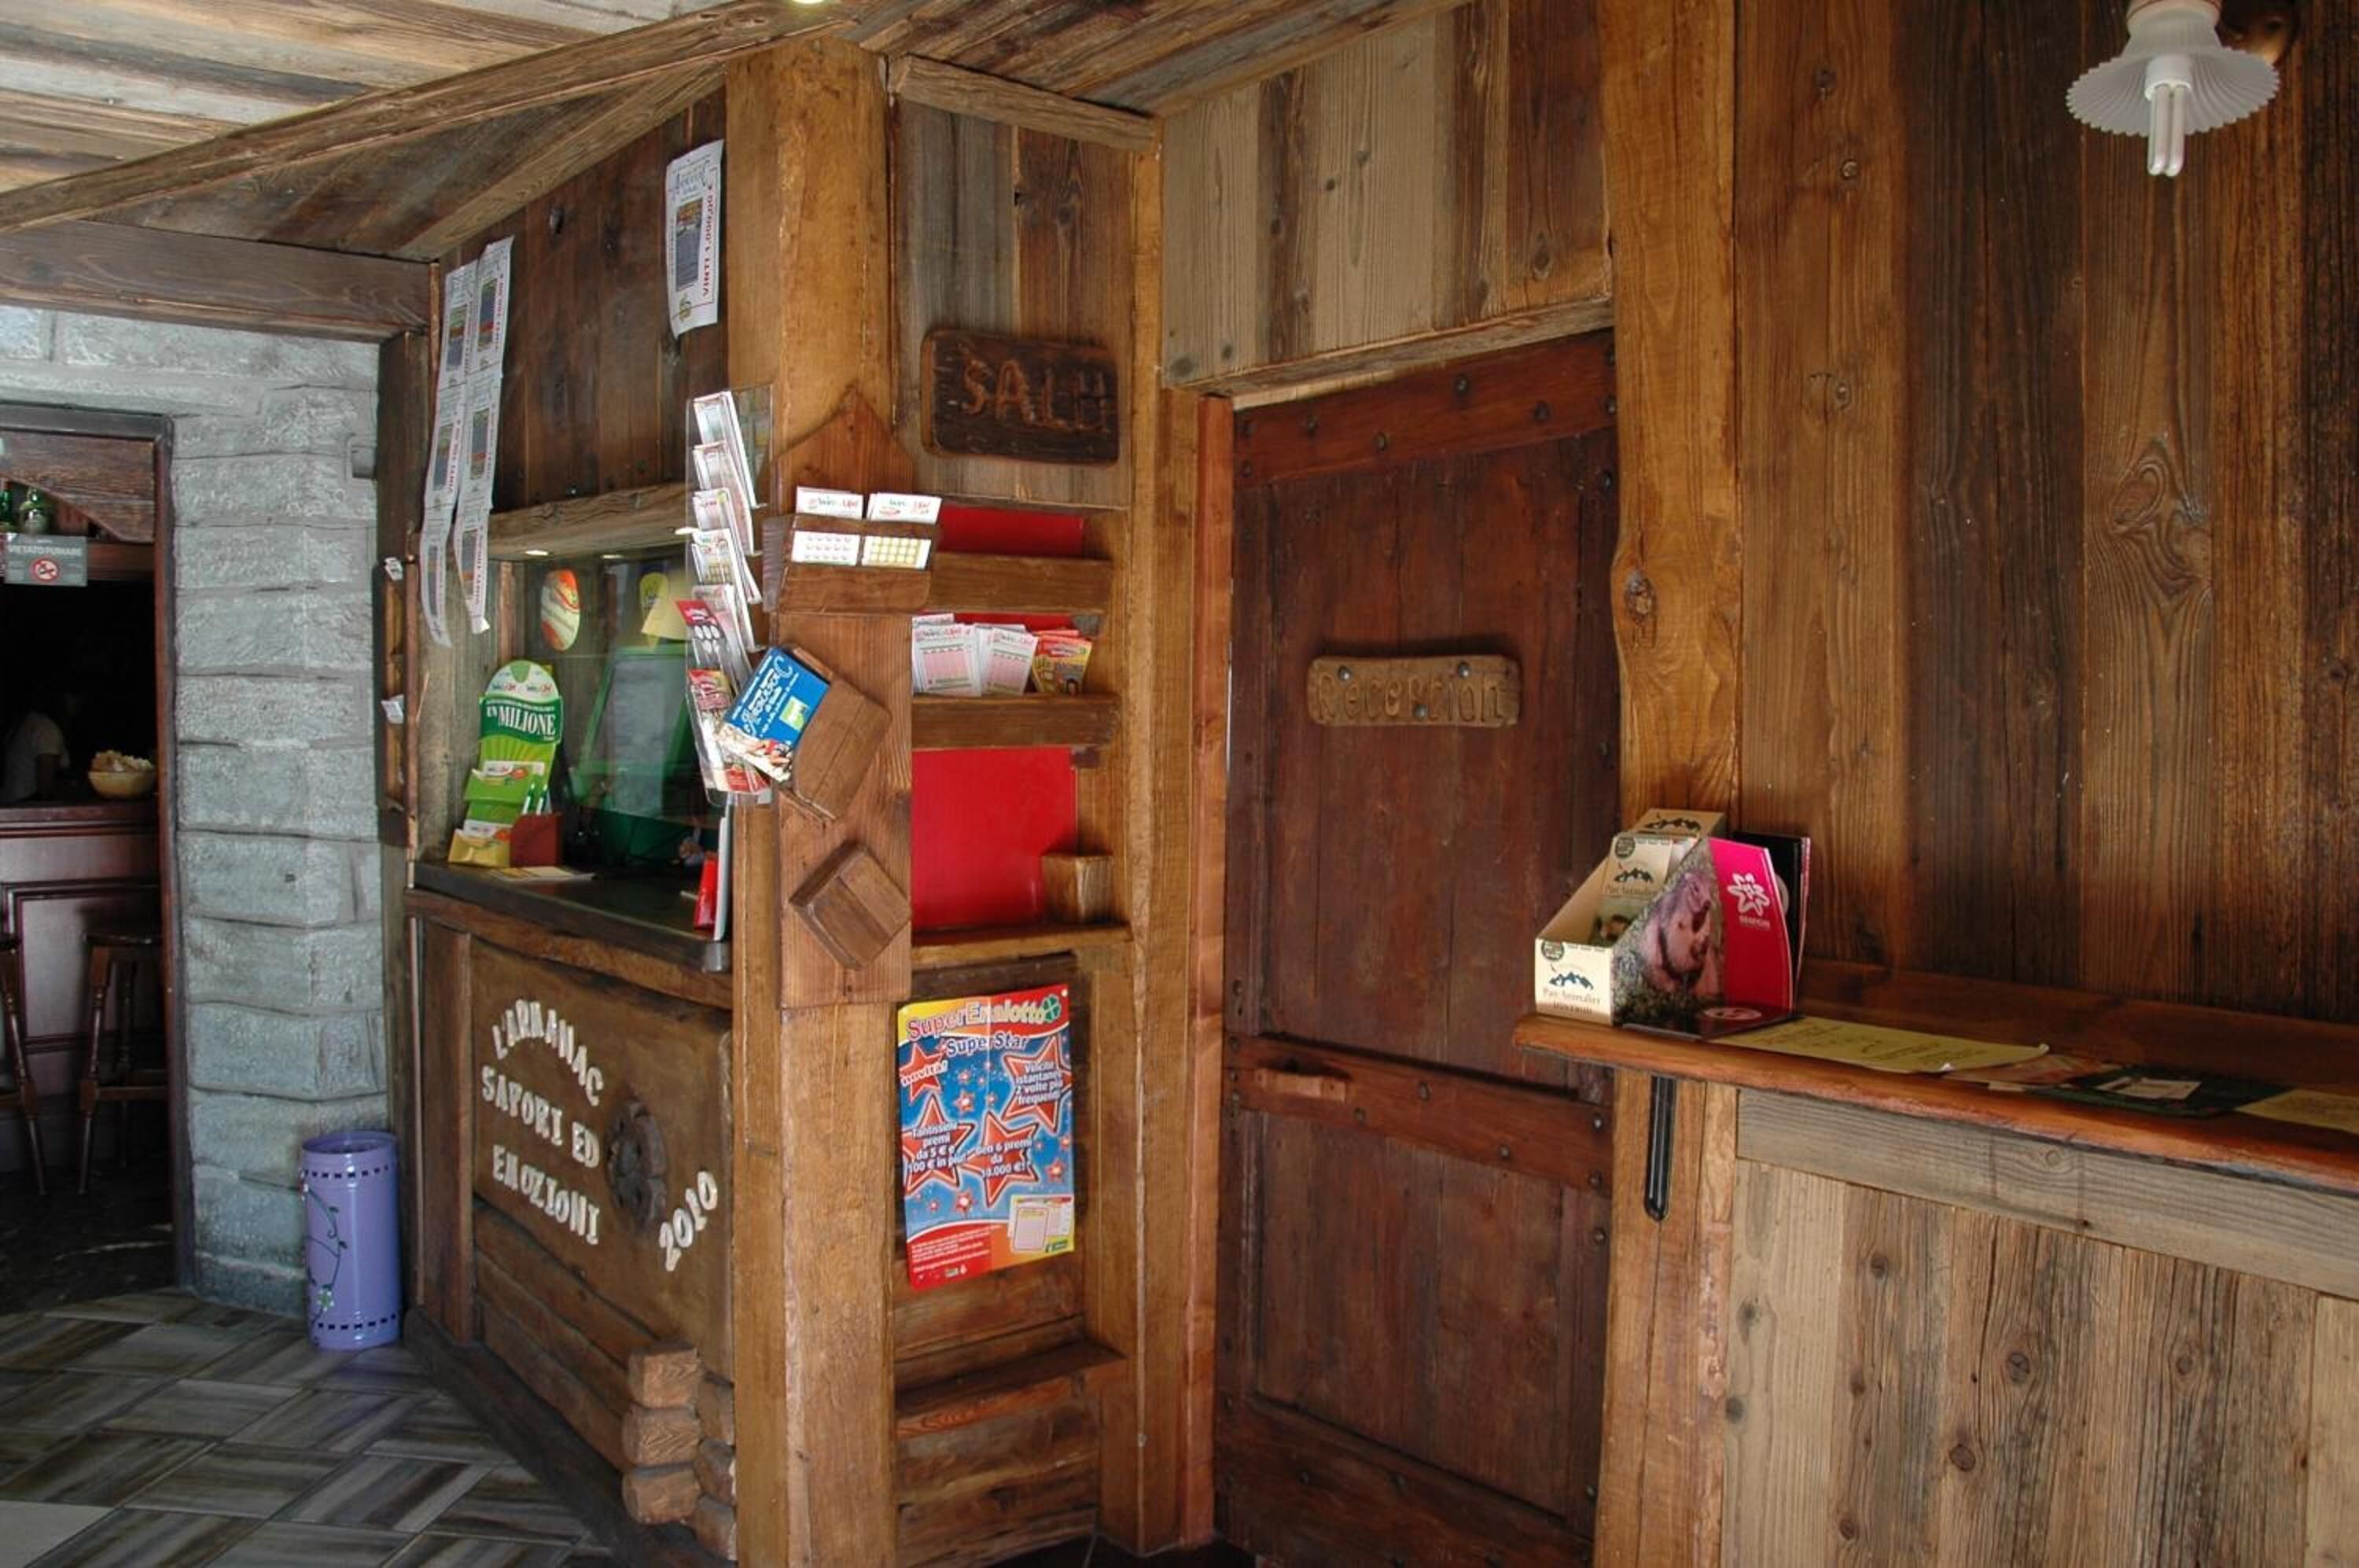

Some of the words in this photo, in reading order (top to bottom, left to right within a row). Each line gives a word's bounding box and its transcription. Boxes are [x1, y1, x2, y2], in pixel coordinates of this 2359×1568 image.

[1318, 673, 1505, 722] Reception
[498, 705, 556, 736] MILIONE
[907, 999, 1046, 1041] SuperEnalotto
[946, 1030, 1029, 1058] SuperStar
[481, 1065, 563, 1147] SAPORI
[571, 1121, 600, 1168] ED
[922, 1132, 951, 1148] premi
[1004, 1139, 1032, 1153] premi
[908, 1161, 926, 1172] 100
[937, 1155, 947, 1167] in
[916, 1150, 928, 1161] da
[990, 1153, 1003, 1165] da
[492, 1144, 600, 1246] EMOZIONI
[659, 1171, 718, 1272] 2010
